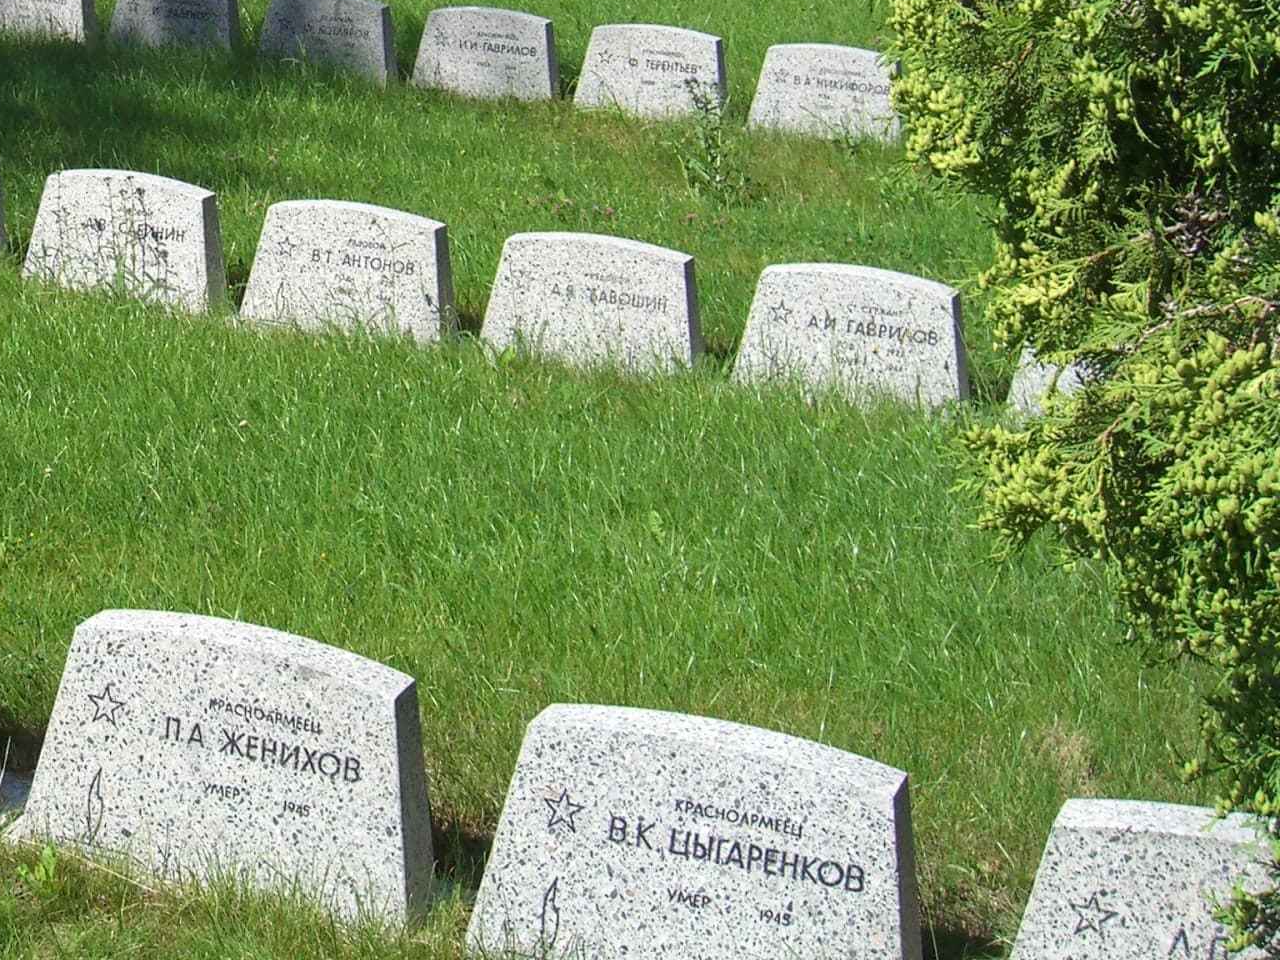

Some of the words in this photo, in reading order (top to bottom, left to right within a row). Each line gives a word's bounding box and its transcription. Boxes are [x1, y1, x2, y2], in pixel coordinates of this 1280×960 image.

[482, 41, 537, 57] ГАВРИЛОВ
[645, 59, 698, 75] ТЕРЕНТЬЕВ
[816, 77, 890, 96] НИКИФОРОВ
[341, 253, 416, 276] АНТОНОВ
[846, 319, 939, 346] ГАВРИЛОВ
[208, 698, 322, 734] КРАСНОАРМЕЕЦ
[218, 727, 362, 783] ЖЕНИХОВ
[202, 781, 242, 799] УМЕР
[282, 799, 312, 817] 1945
[674, 798, 803, 839] КРАСНОАРМЕЕЦ
[668, 828, 865, 894] ЦЫГАРЕНКОВ
[666, 887, 712, 908] УМЕР
